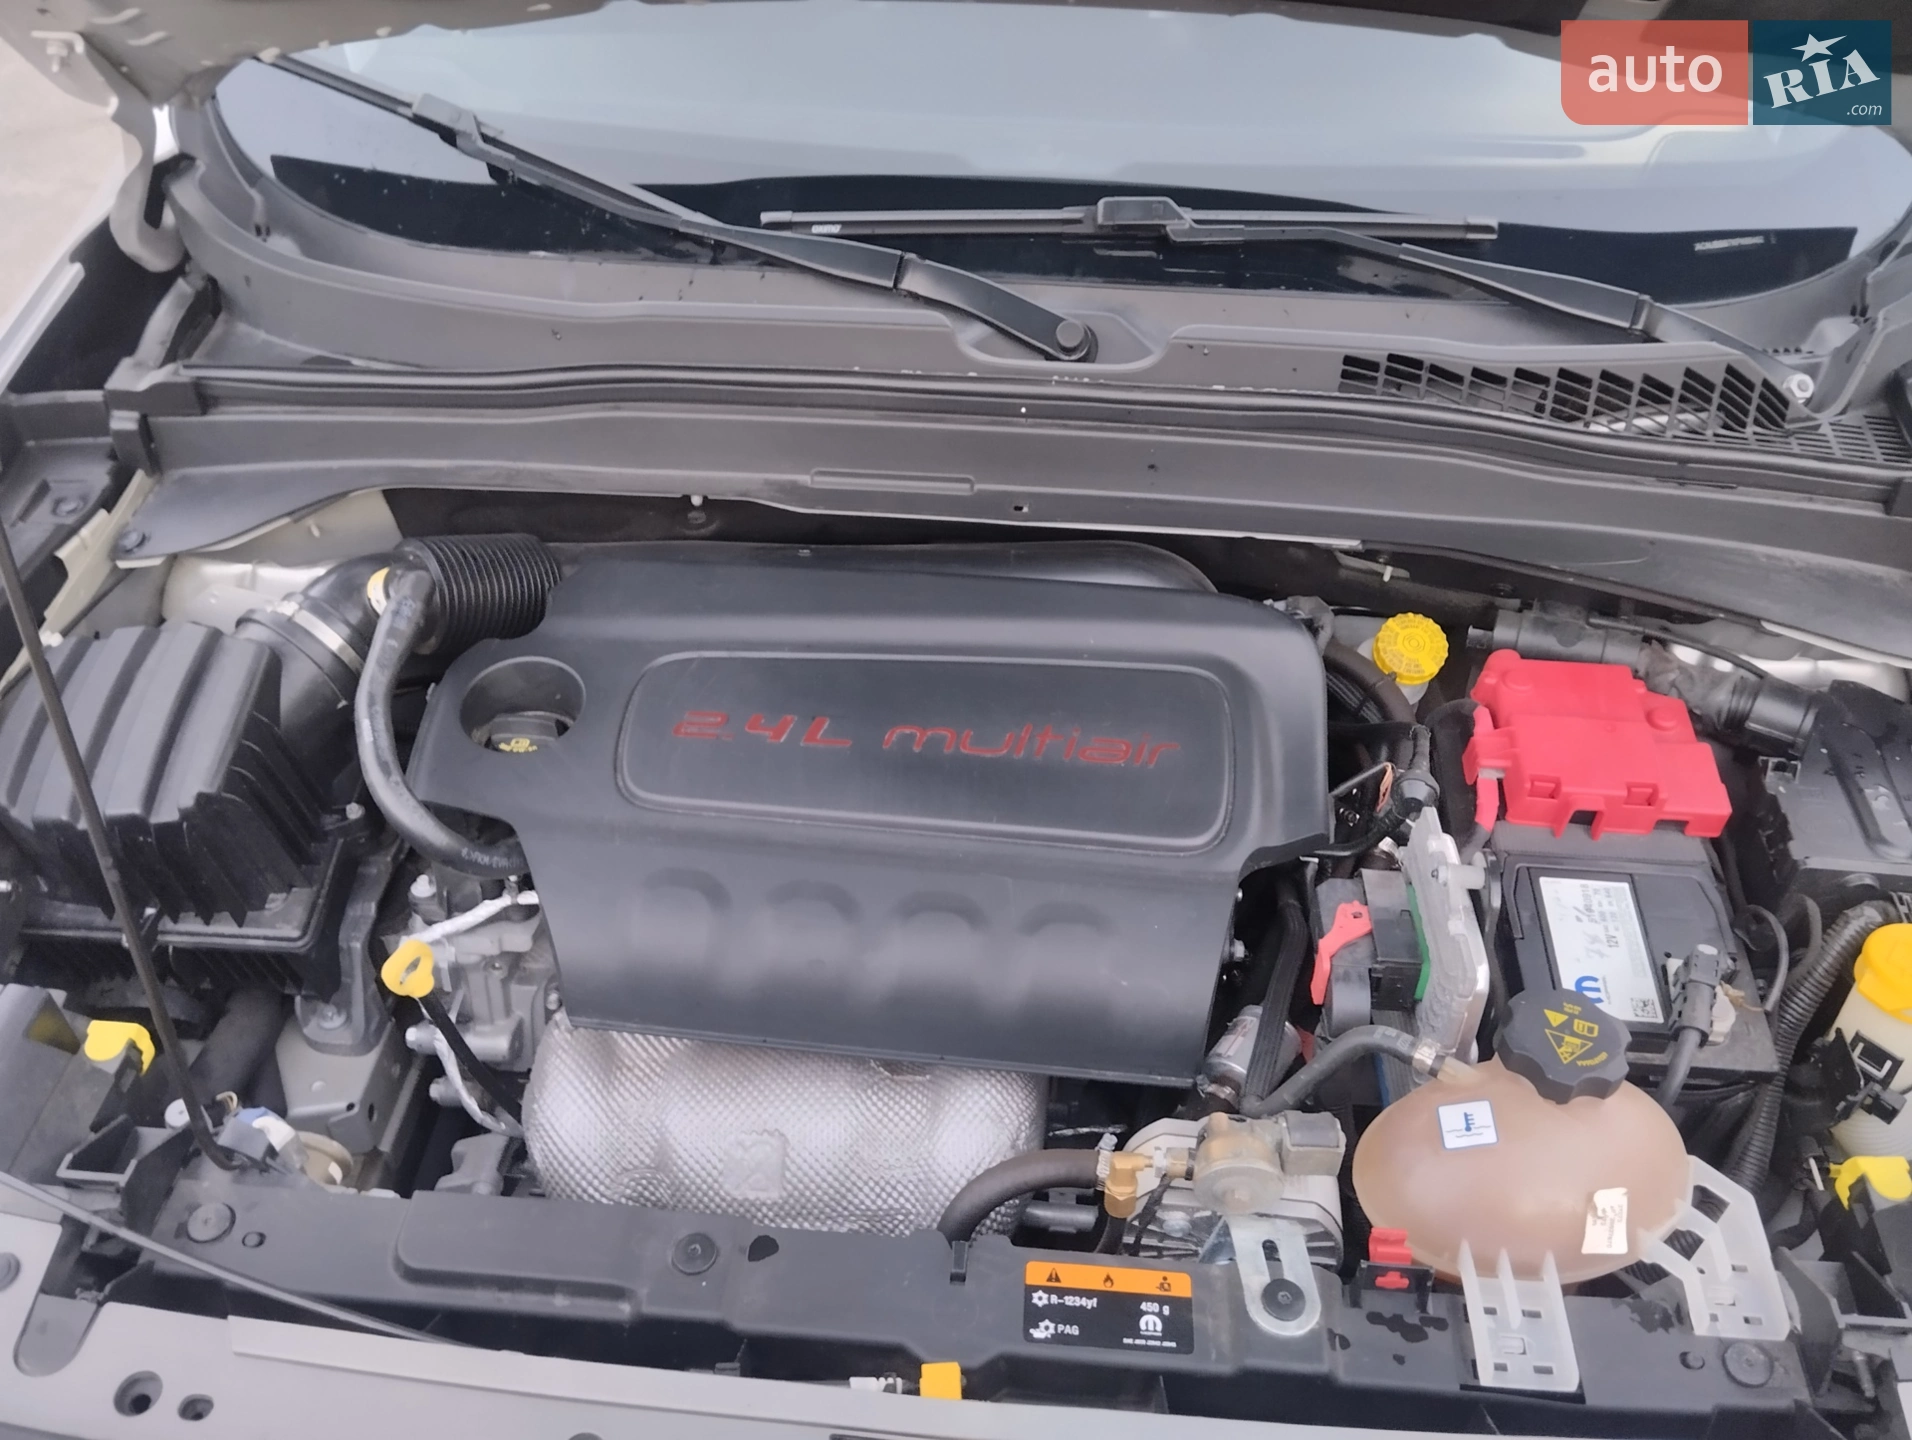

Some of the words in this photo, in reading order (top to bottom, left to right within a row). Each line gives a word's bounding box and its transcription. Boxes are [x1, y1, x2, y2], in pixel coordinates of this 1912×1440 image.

[672, 710, 853, 747] 2.4L
[882, 722, 1181, 768] multiair
[1605, 934, 1619, 948] 12V
[1049, 1294, 1097, 1309] R-1234yf
[1140, 1301, 1159, 1313] 450
[1162, 1305, 1170, 1316] g
[1057, 1324, 1080, 1336] PAG
